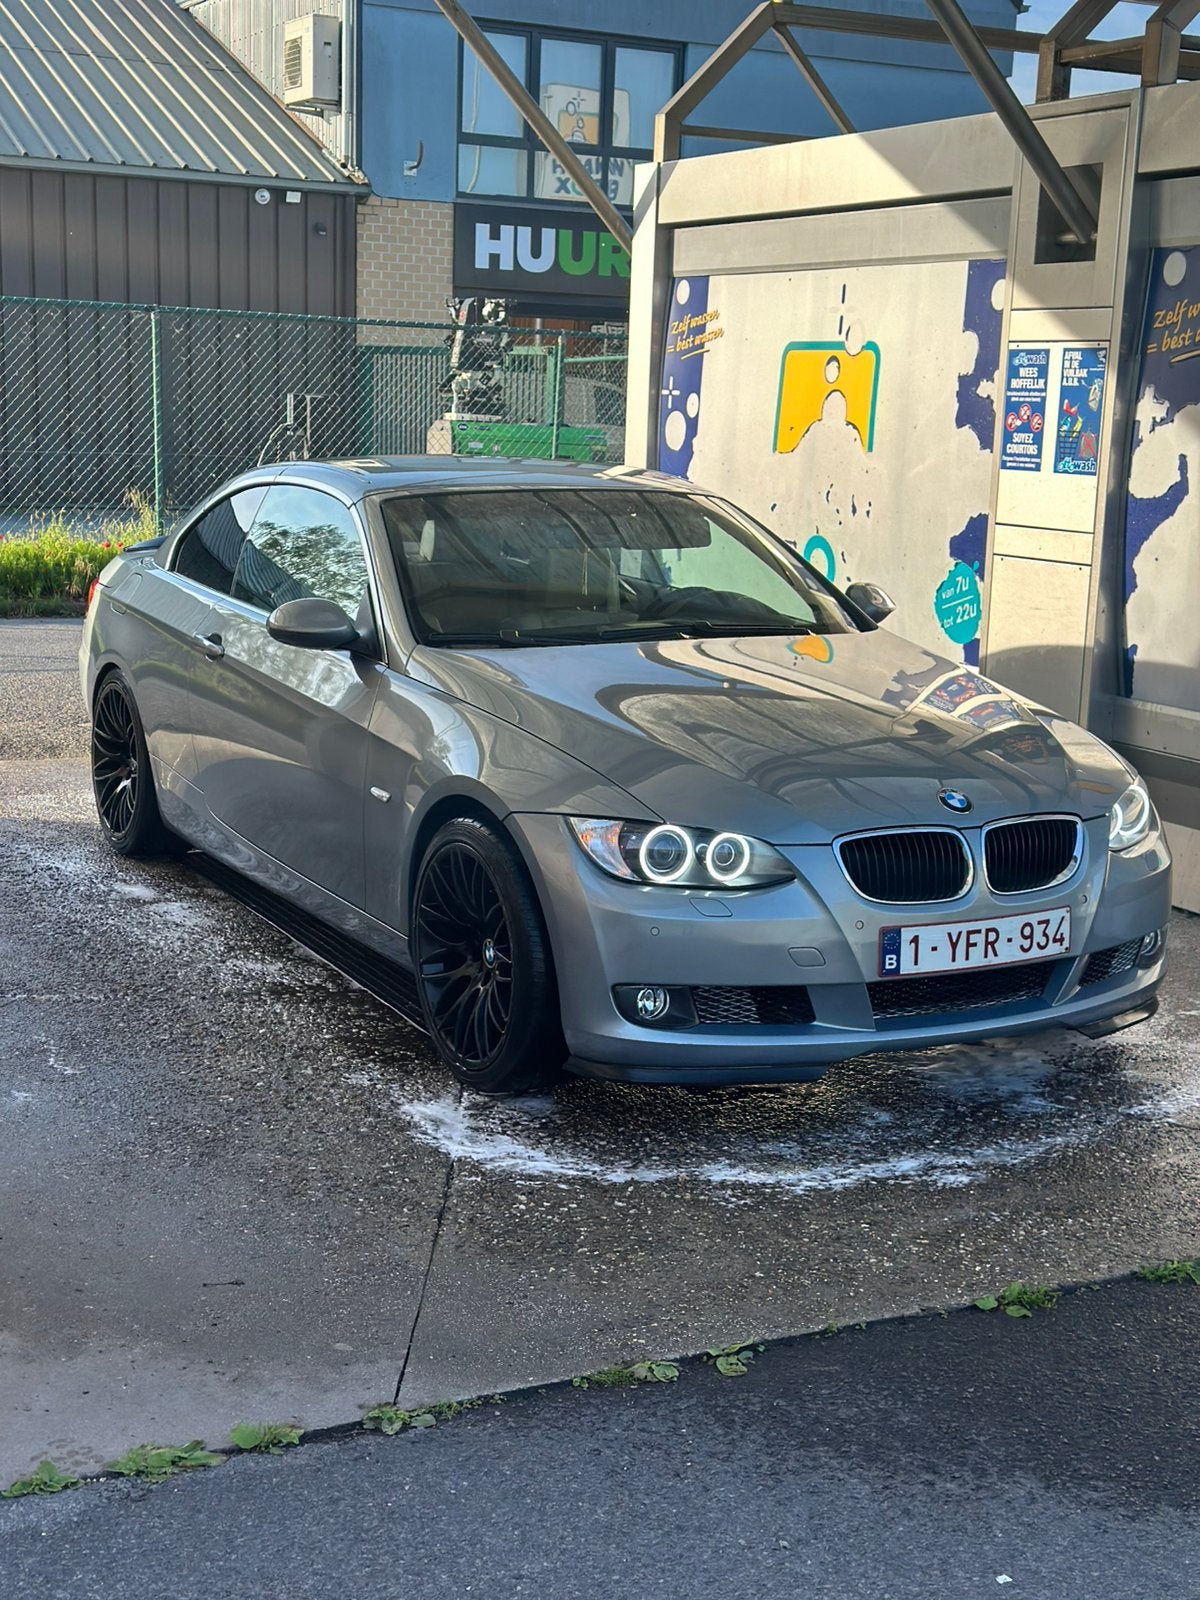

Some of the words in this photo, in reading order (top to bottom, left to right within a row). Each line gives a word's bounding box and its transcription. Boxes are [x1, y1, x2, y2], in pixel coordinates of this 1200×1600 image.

[475, 222, 631, 278] HUUR
[671, 313, 691, 339] Zelf
[1153, 298, 1188, 334] Zelf
[676, 334, 694, 352] best
[1162, 327, 1194, 352] best
[1019, 367, 1038, 378] WEES
[941, 588, 955, 599] van
[943, 616, 954, 628] tot
[909, 915, 1065, 966] 1-YFR-934
[884, 954, 897, 969] B
